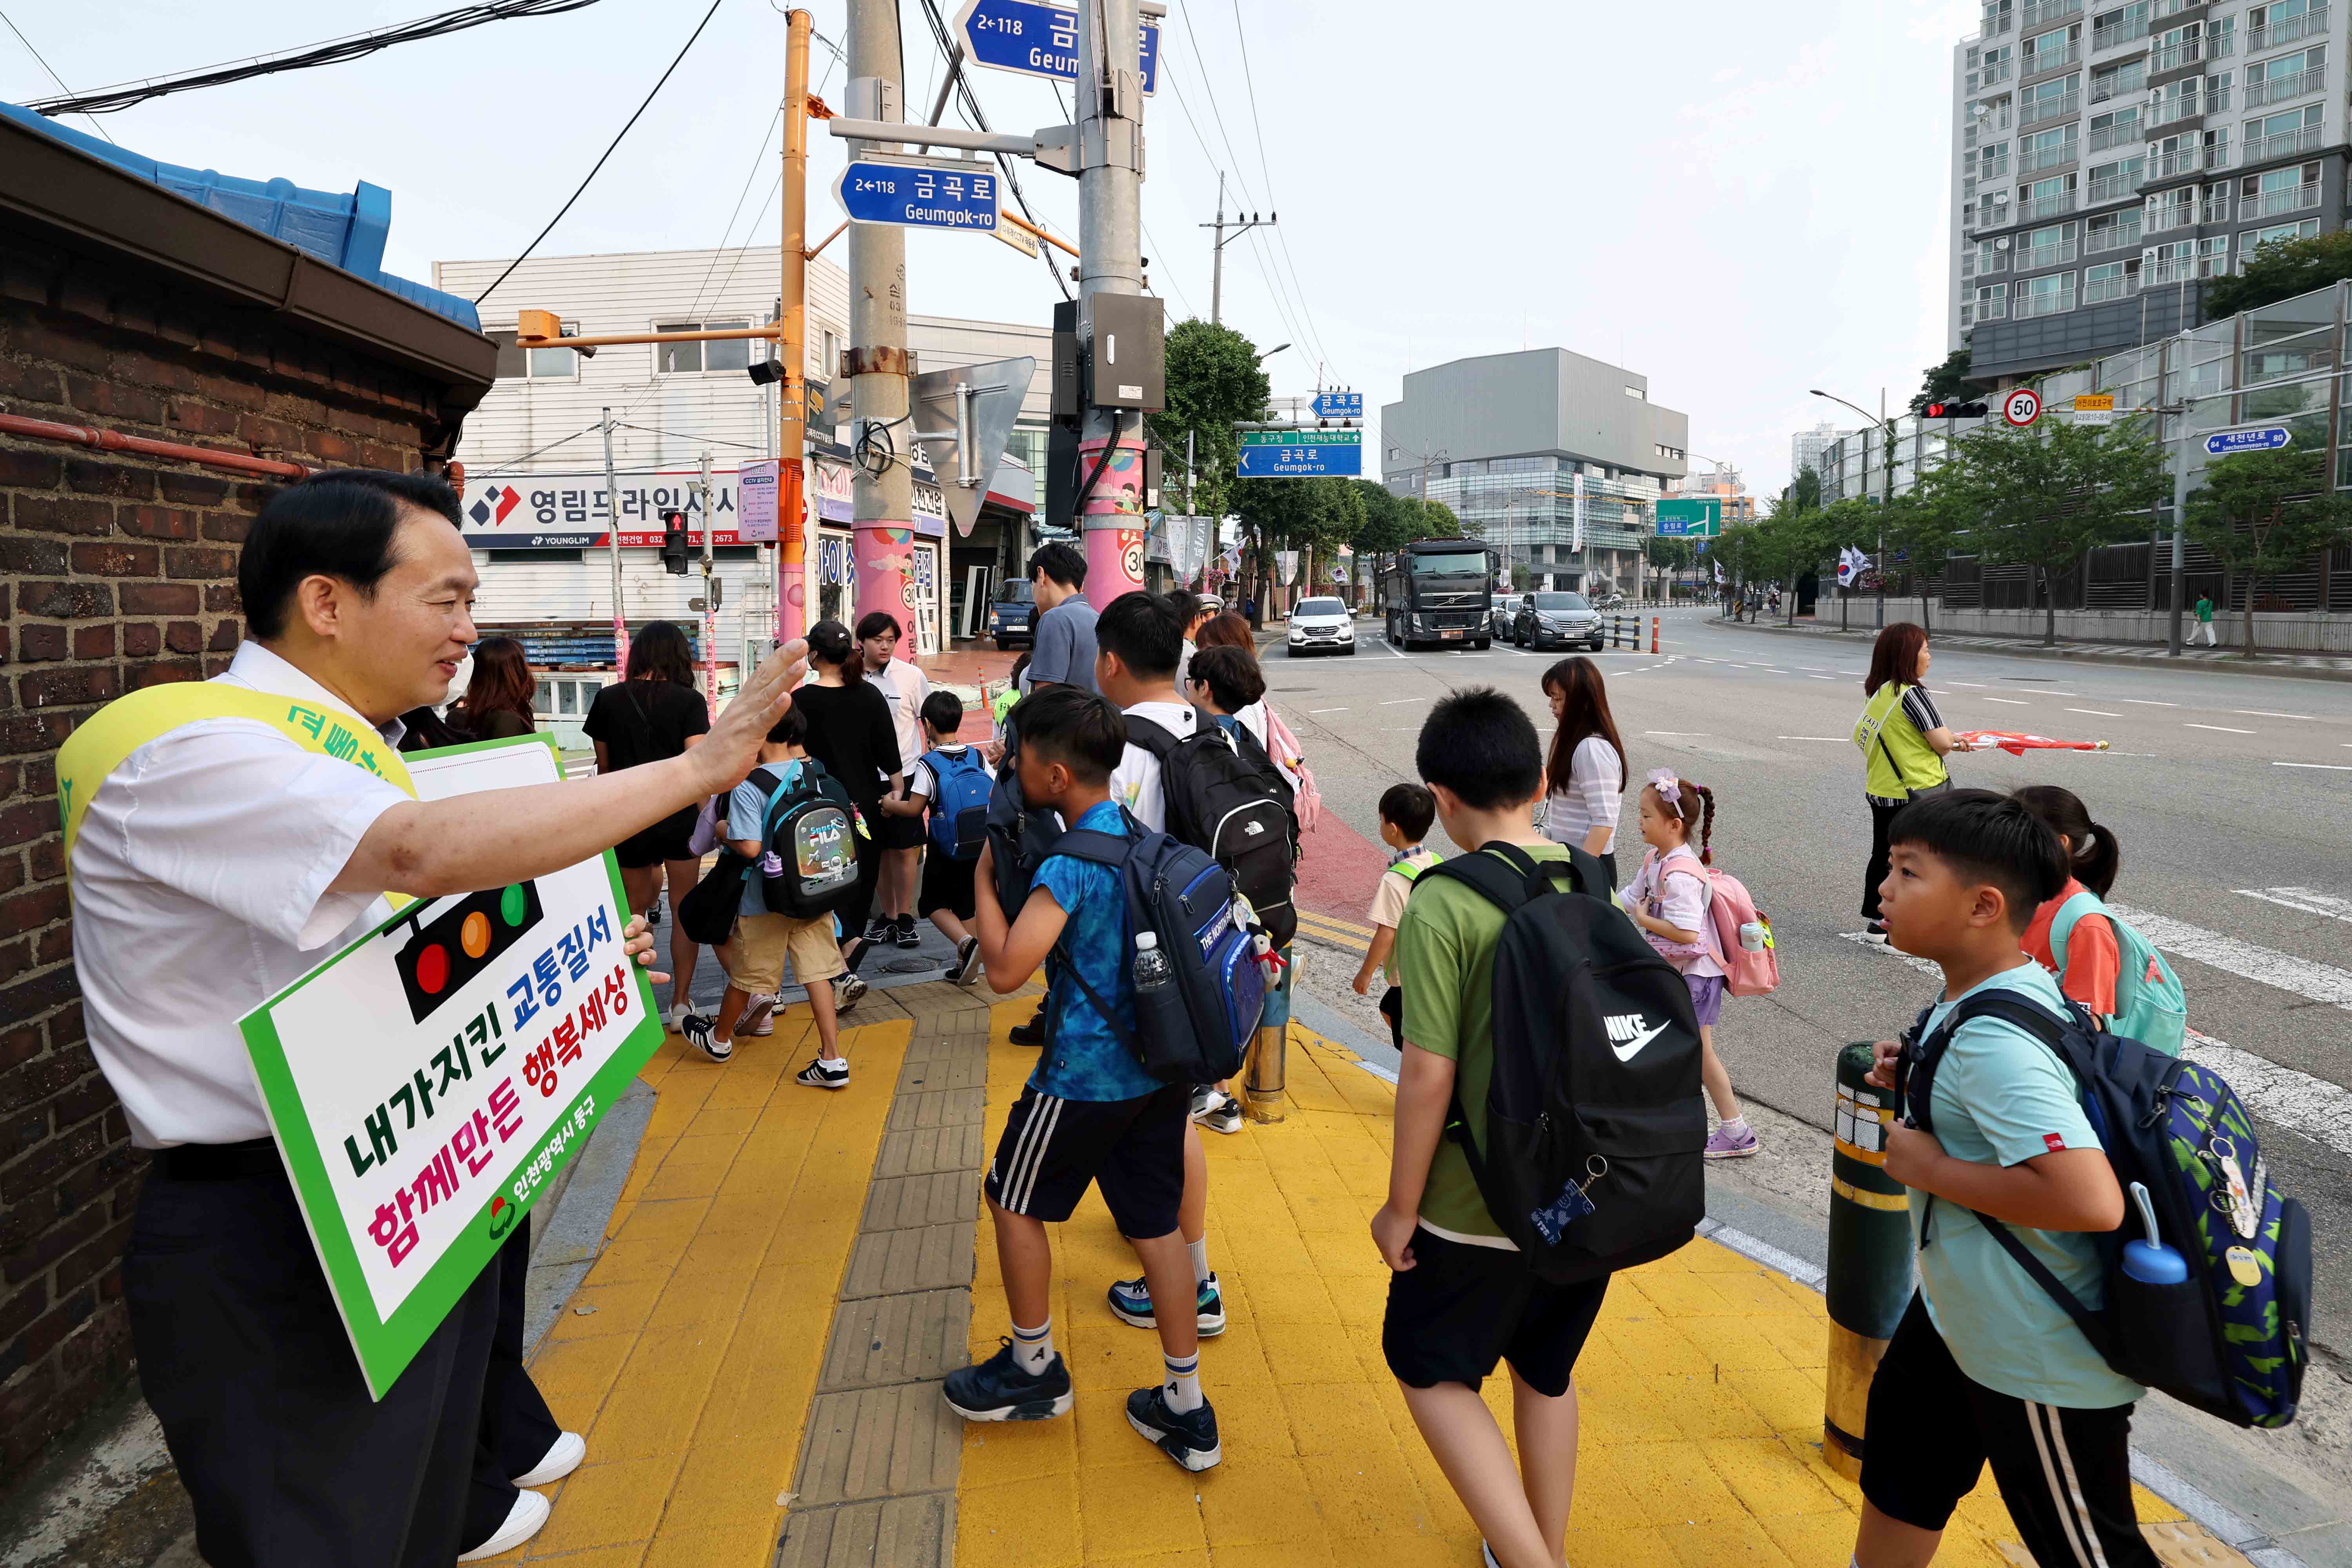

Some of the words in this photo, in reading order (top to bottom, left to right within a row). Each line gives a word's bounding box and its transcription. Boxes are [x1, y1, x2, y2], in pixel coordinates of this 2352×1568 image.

[915, 174, 992, 201] 금곡로
[906, 204, 993, 225] Geumgok-ro
[1321, 395, 1361, 407] 금곡로
[2076, 398, 2112, 408] 어린이보호구역
[1322, 407, 1360, 416] Geumgok-ro
[2014, 400, 2033, 416] 50
[1261, 435, 1283, 443] 동구청
[1303, 434, 1350, 443] 인천재능대학교
[2227, 432, 2267, 443] 새천년로
[2222, 442, 2270, 451] Saecheonnyeon-ro
[1280, 449, 1318, 462] 금곡로
[1274, 463, 1325, 473] Geumgok-ro
[545, 536, 589, 544] YOUNGLIM
[1863, 715, 1878, 730] (사)
[810, 824, 836, 835] Space
[809, 828, 840, 847] FILA
[1200, 932, 1214, 950] THE
[1212, 915, 1228, 940] NORTH
[1603, 1013, 1648, 1041] NIKE
[344, 1001, 506, 1178] 내가지킨
[507, 904, 612, 1032] 교통질서
[368, 1077, 523, 1268] 함께만든
[522, 965, 628, 1098] 행복세상
[514, 1120, 574, 1202] 인천광역시
[573, 1095, 595, 1130] 동구
